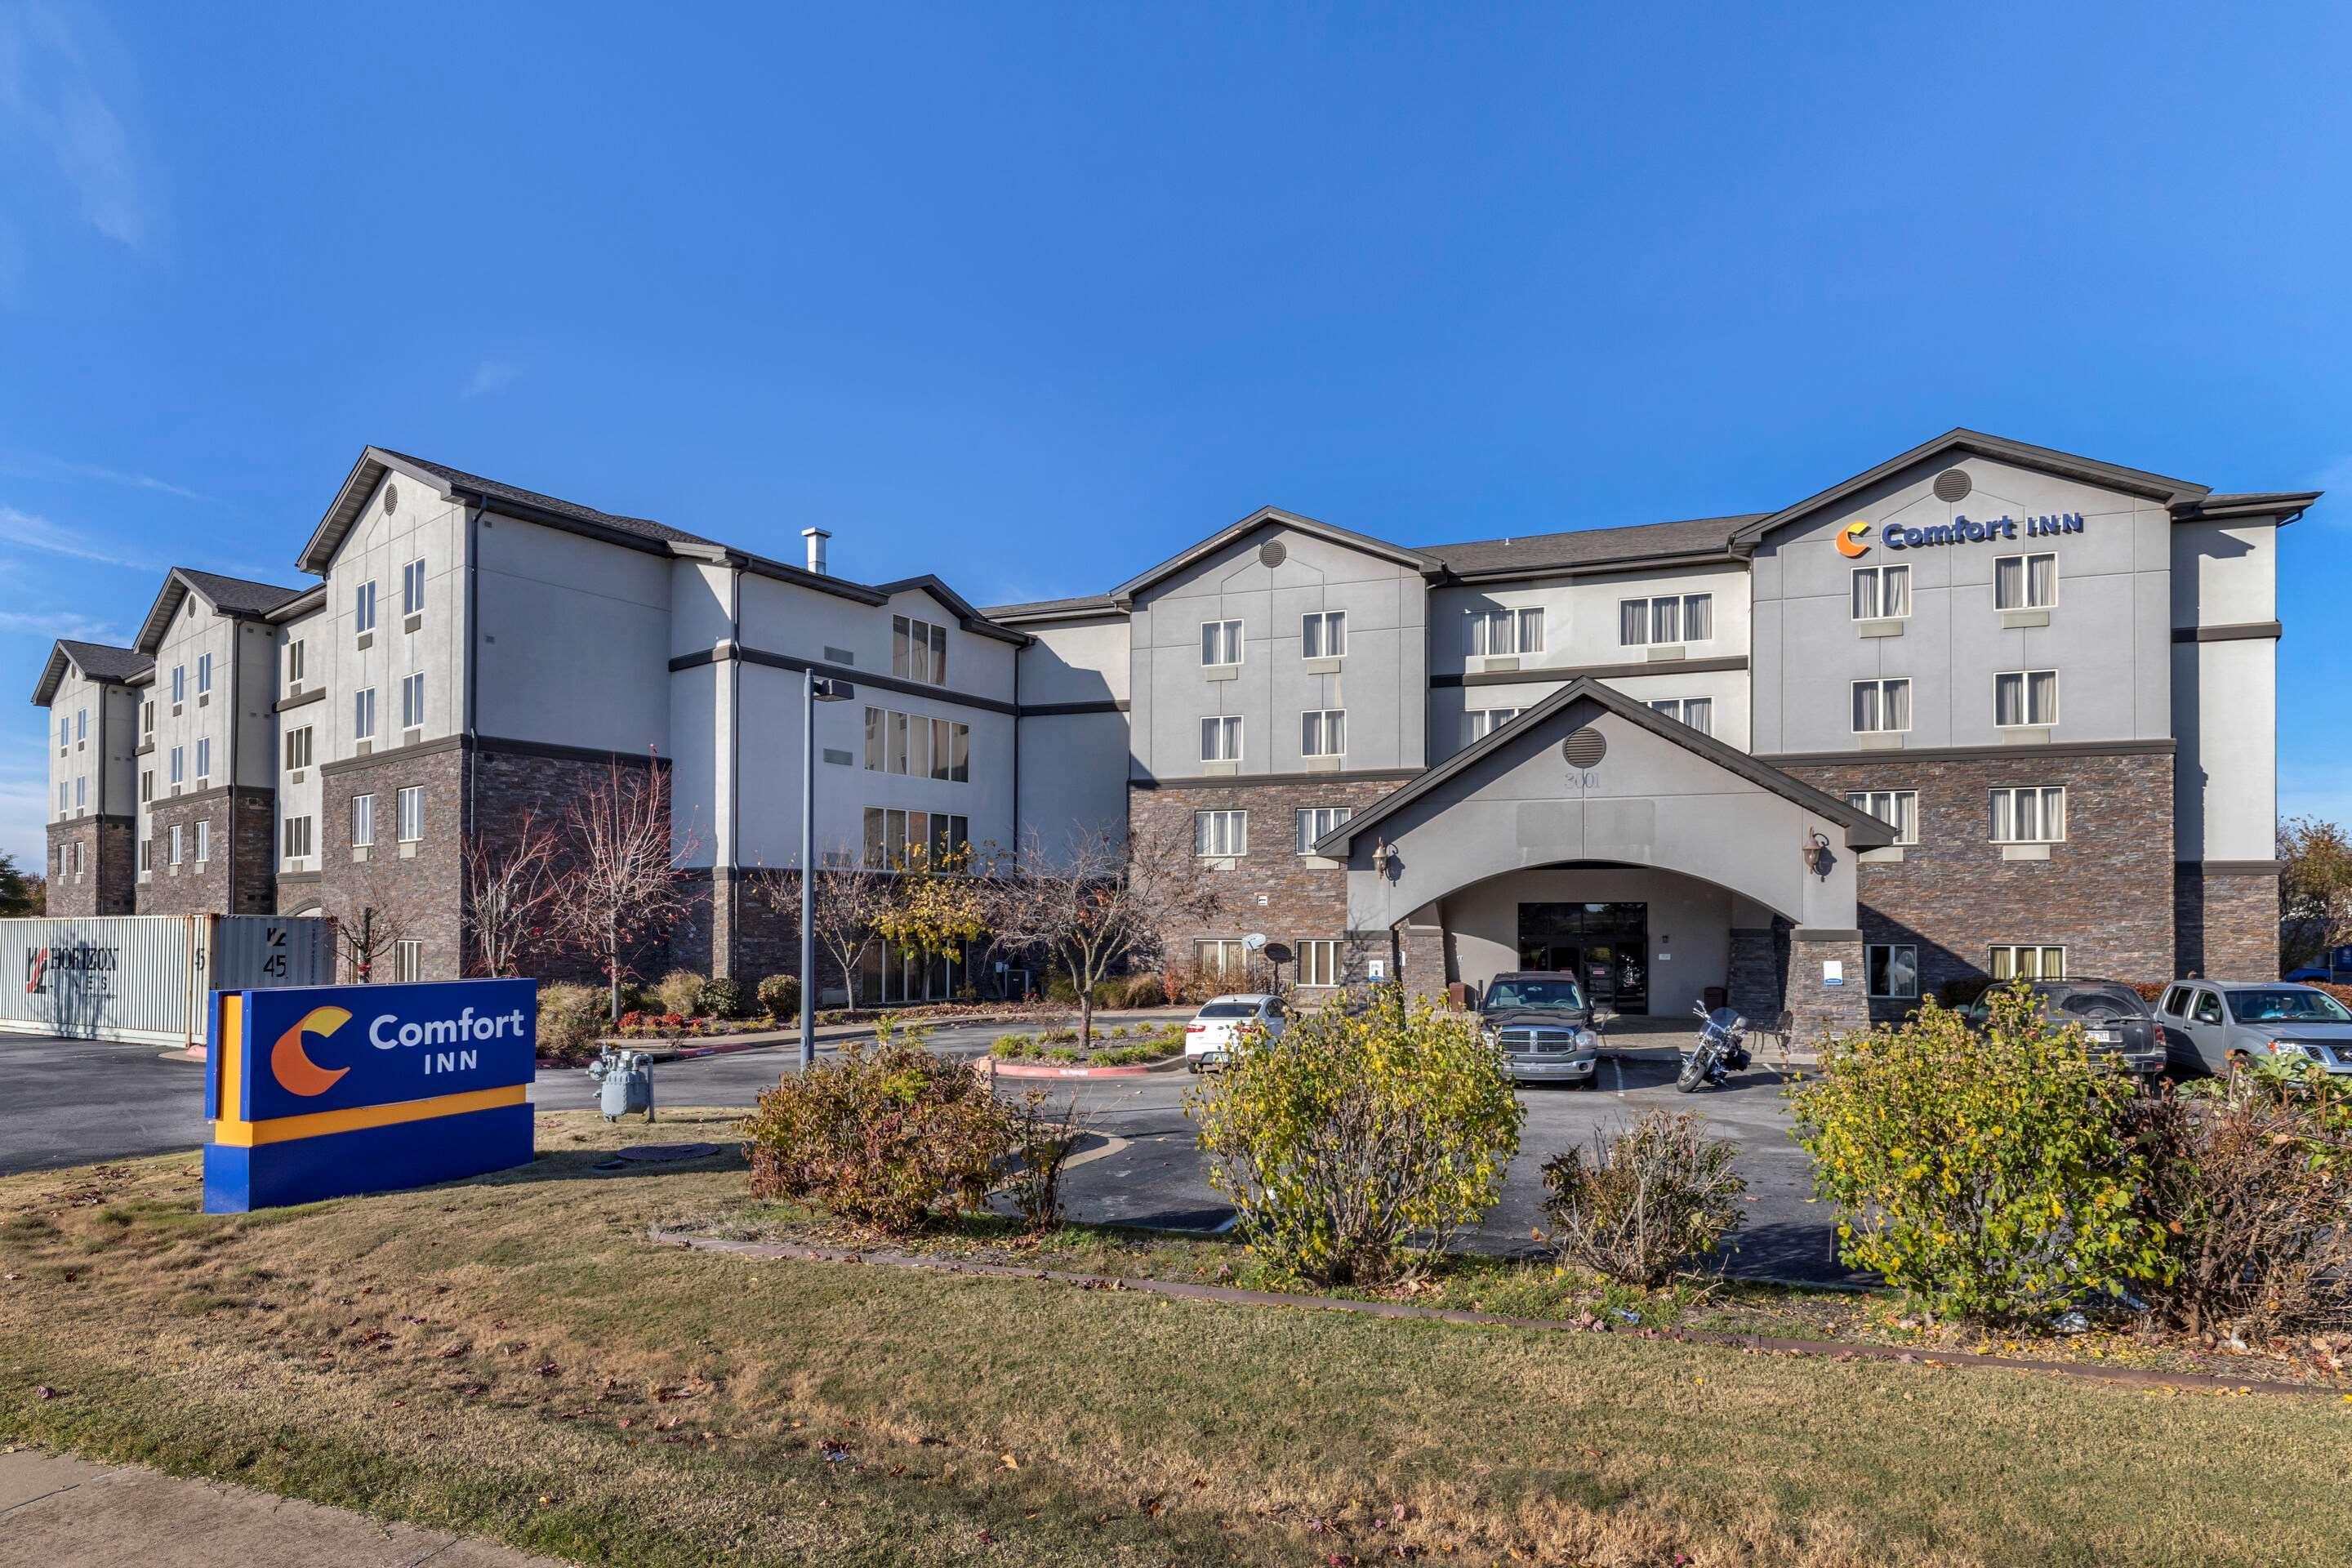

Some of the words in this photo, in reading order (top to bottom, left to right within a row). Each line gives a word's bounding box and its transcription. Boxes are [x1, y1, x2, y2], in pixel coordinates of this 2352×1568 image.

[1881, 514, 2014, 548] Comfort
[2026, 512, 2080, 535] INN
[1564, 773, 1601, 790] 3001
[50, 947, 118, 970] HORIZON
[263, 954, 286, 978] 45
[369, 1007, 524, 1050] Comfort
[425, 1049, 477, 1074] INN
